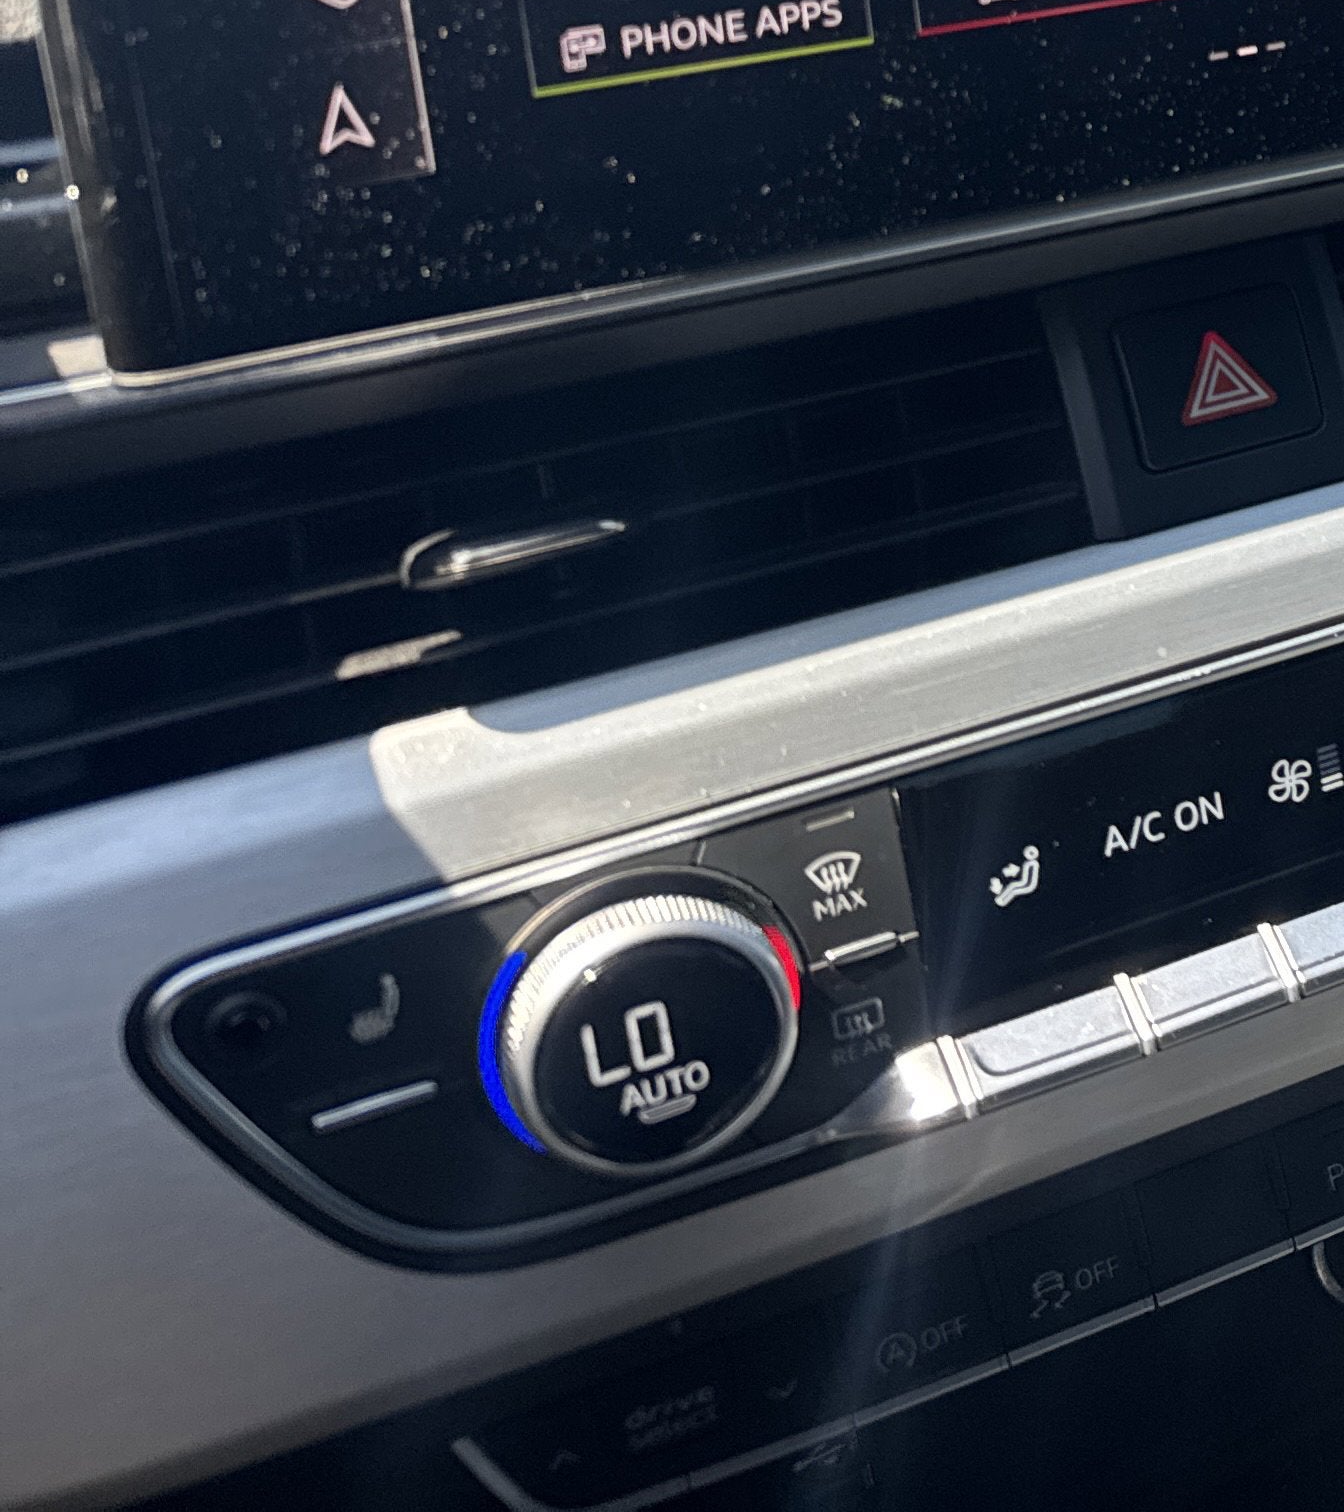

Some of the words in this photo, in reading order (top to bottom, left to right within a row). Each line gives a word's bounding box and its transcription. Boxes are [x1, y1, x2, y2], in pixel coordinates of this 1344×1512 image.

[620, 8, 749, 59] PHONE
[1102, 810, 1167, 858] A/C
[1173, 790, 1226, 834] ON
[812, 890, 868, 922] MAX
[579, 999, 677, 1088] LO
[619, 1059, 711, 1117] AUTO
[1073, 1255, 1122, 1292] OFF
[918, 1314, 970, 1355] OFF
